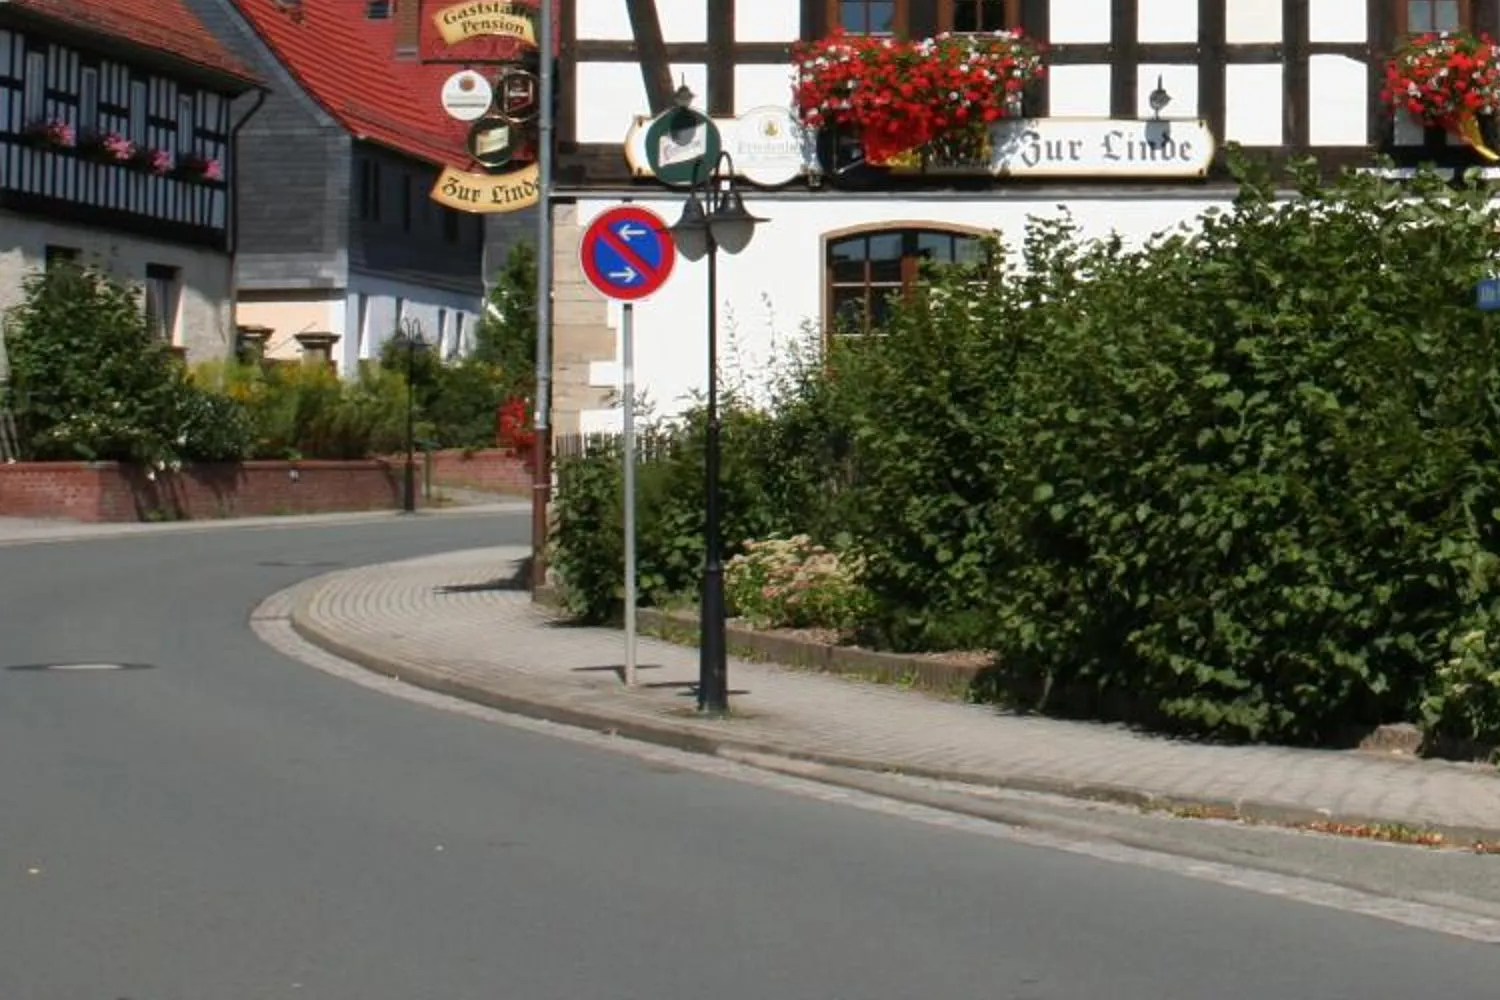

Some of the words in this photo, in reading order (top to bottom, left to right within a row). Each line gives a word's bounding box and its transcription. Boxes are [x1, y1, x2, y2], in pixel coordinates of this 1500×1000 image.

[462, 20, 525, 36] Pension
[1020, 129, 1083, 168] Zur
[1102, 129, 1193, 162] Linde
[442, 176, 481, 203] Zur
